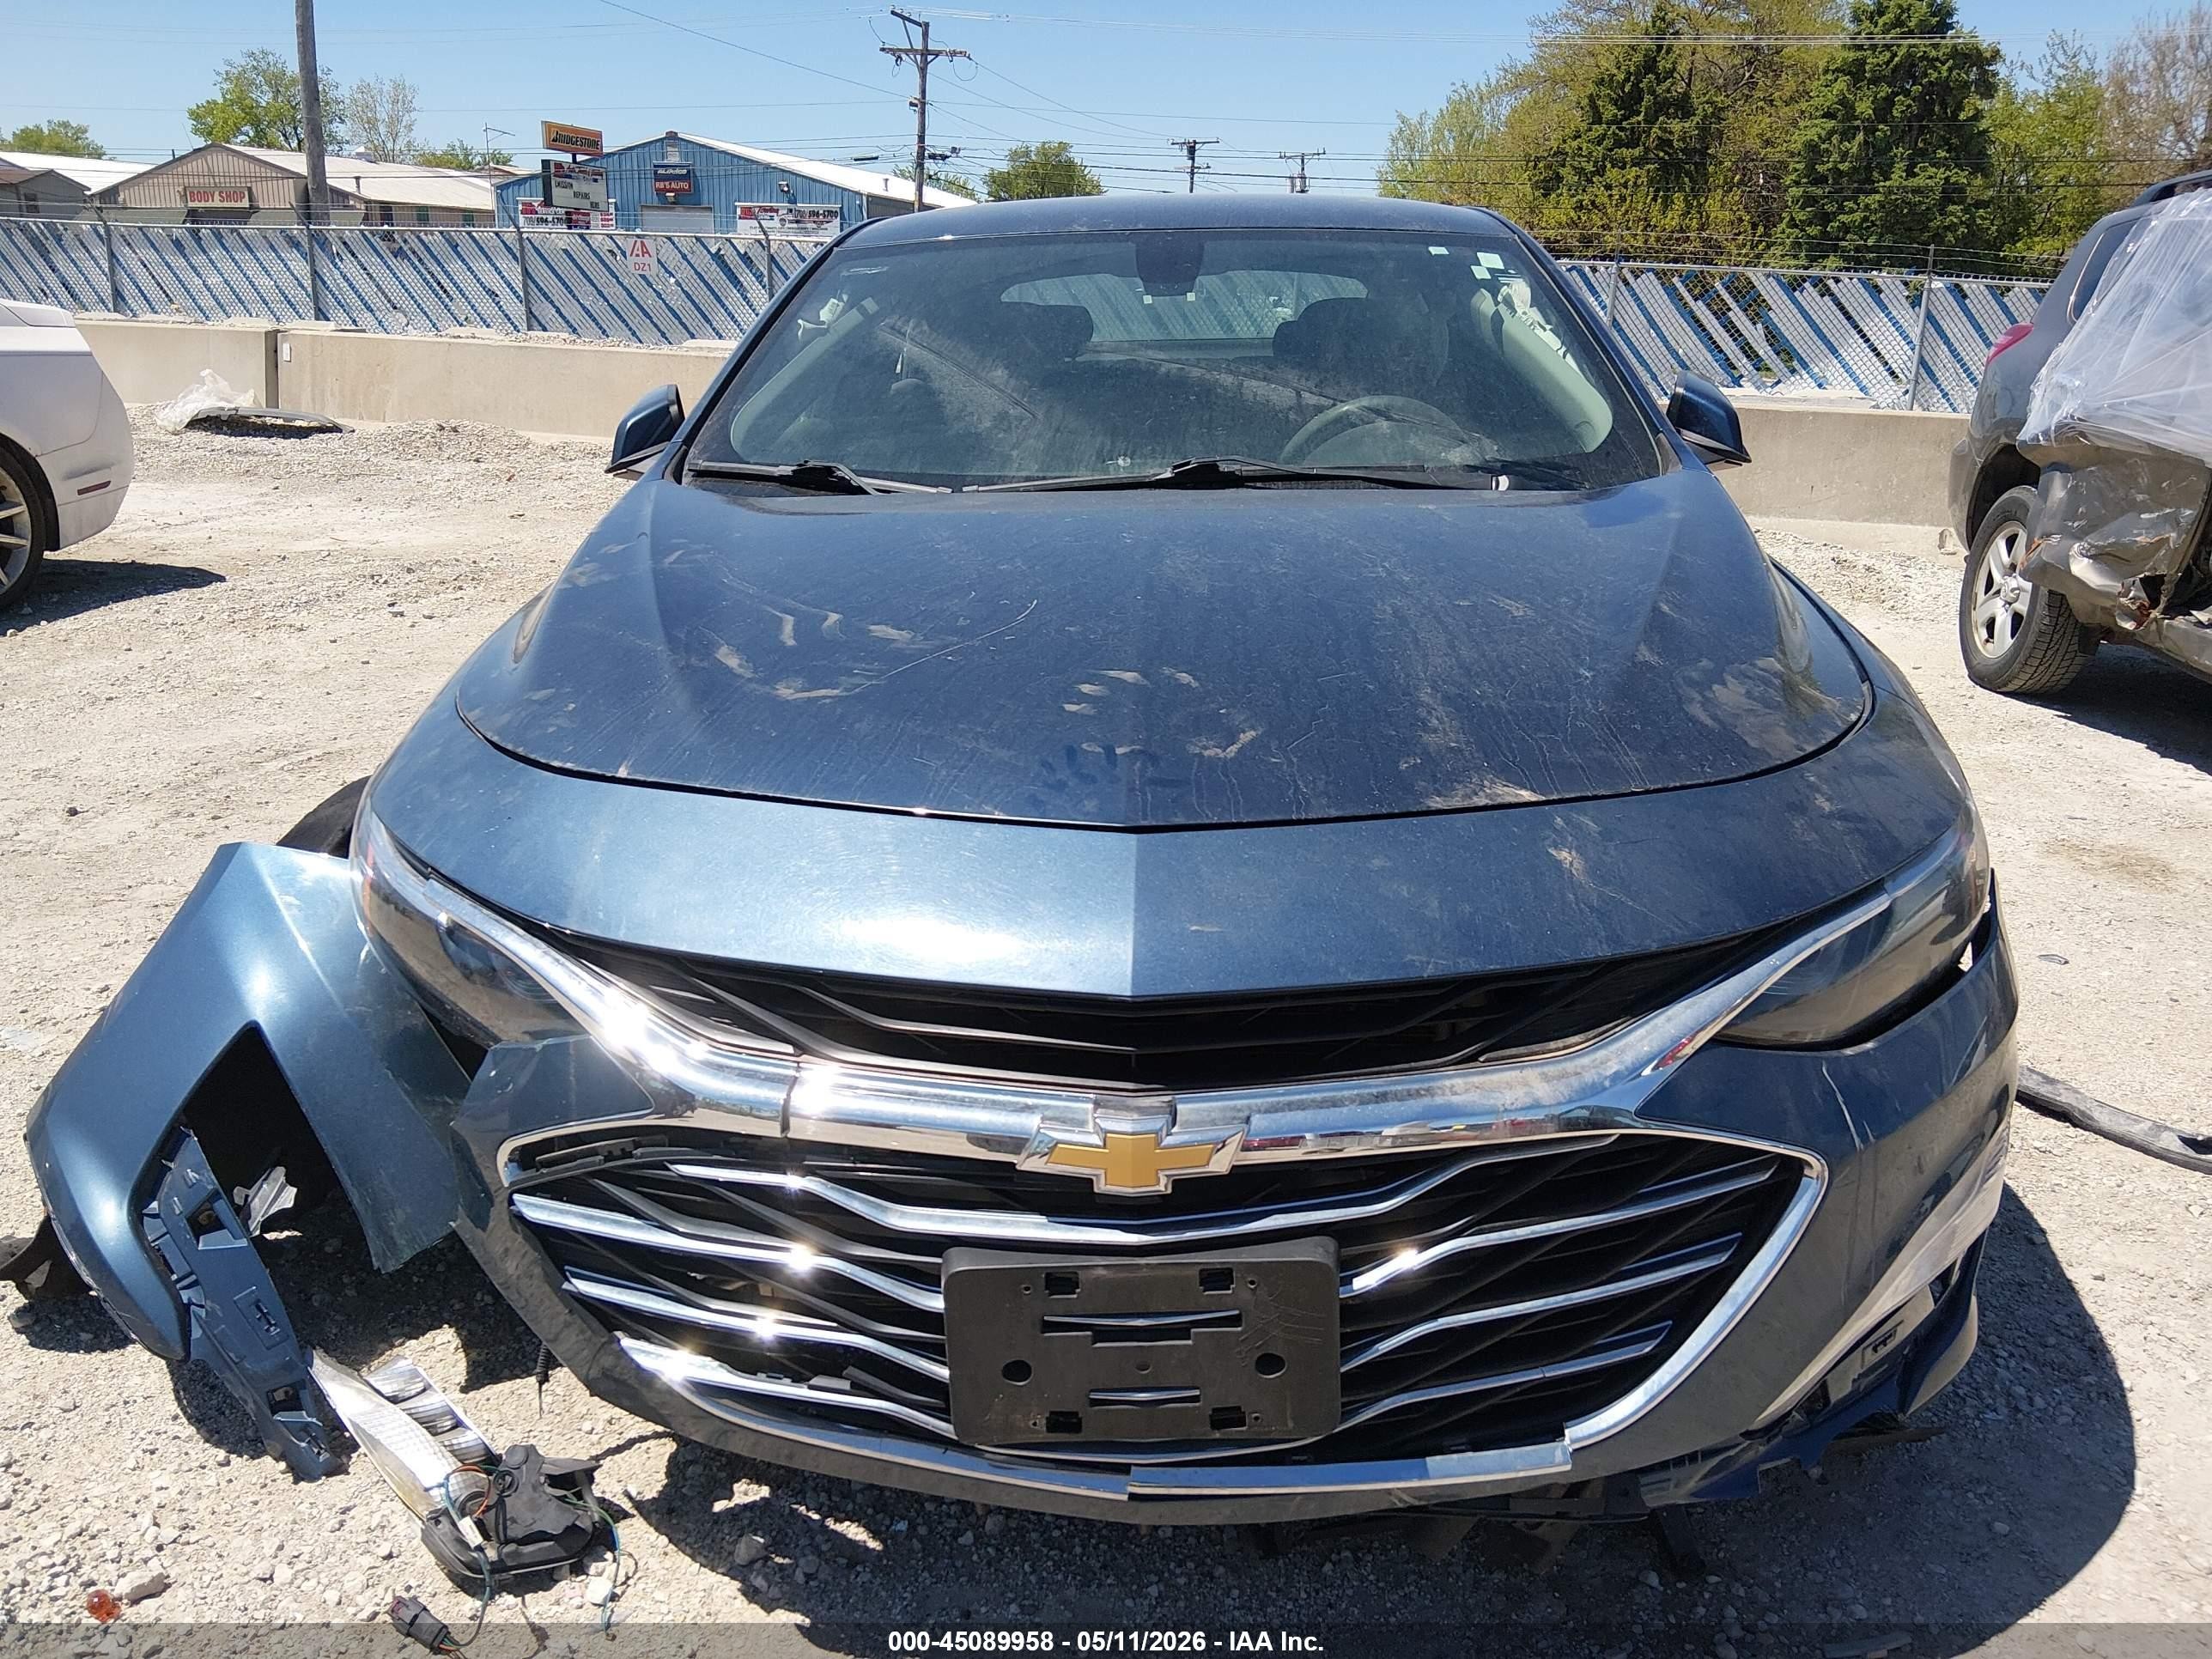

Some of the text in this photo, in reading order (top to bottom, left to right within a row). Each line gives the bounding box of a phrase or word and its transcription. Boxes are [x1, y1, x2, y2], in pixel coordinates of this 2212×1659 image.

[551, 130, 600, 150] BRIDGESTONE
[671, 181, 689, 190] AUTO
[189, 191, 246, 203] BODY SHOP
[573, 191, 591, 200] REPAIRS
